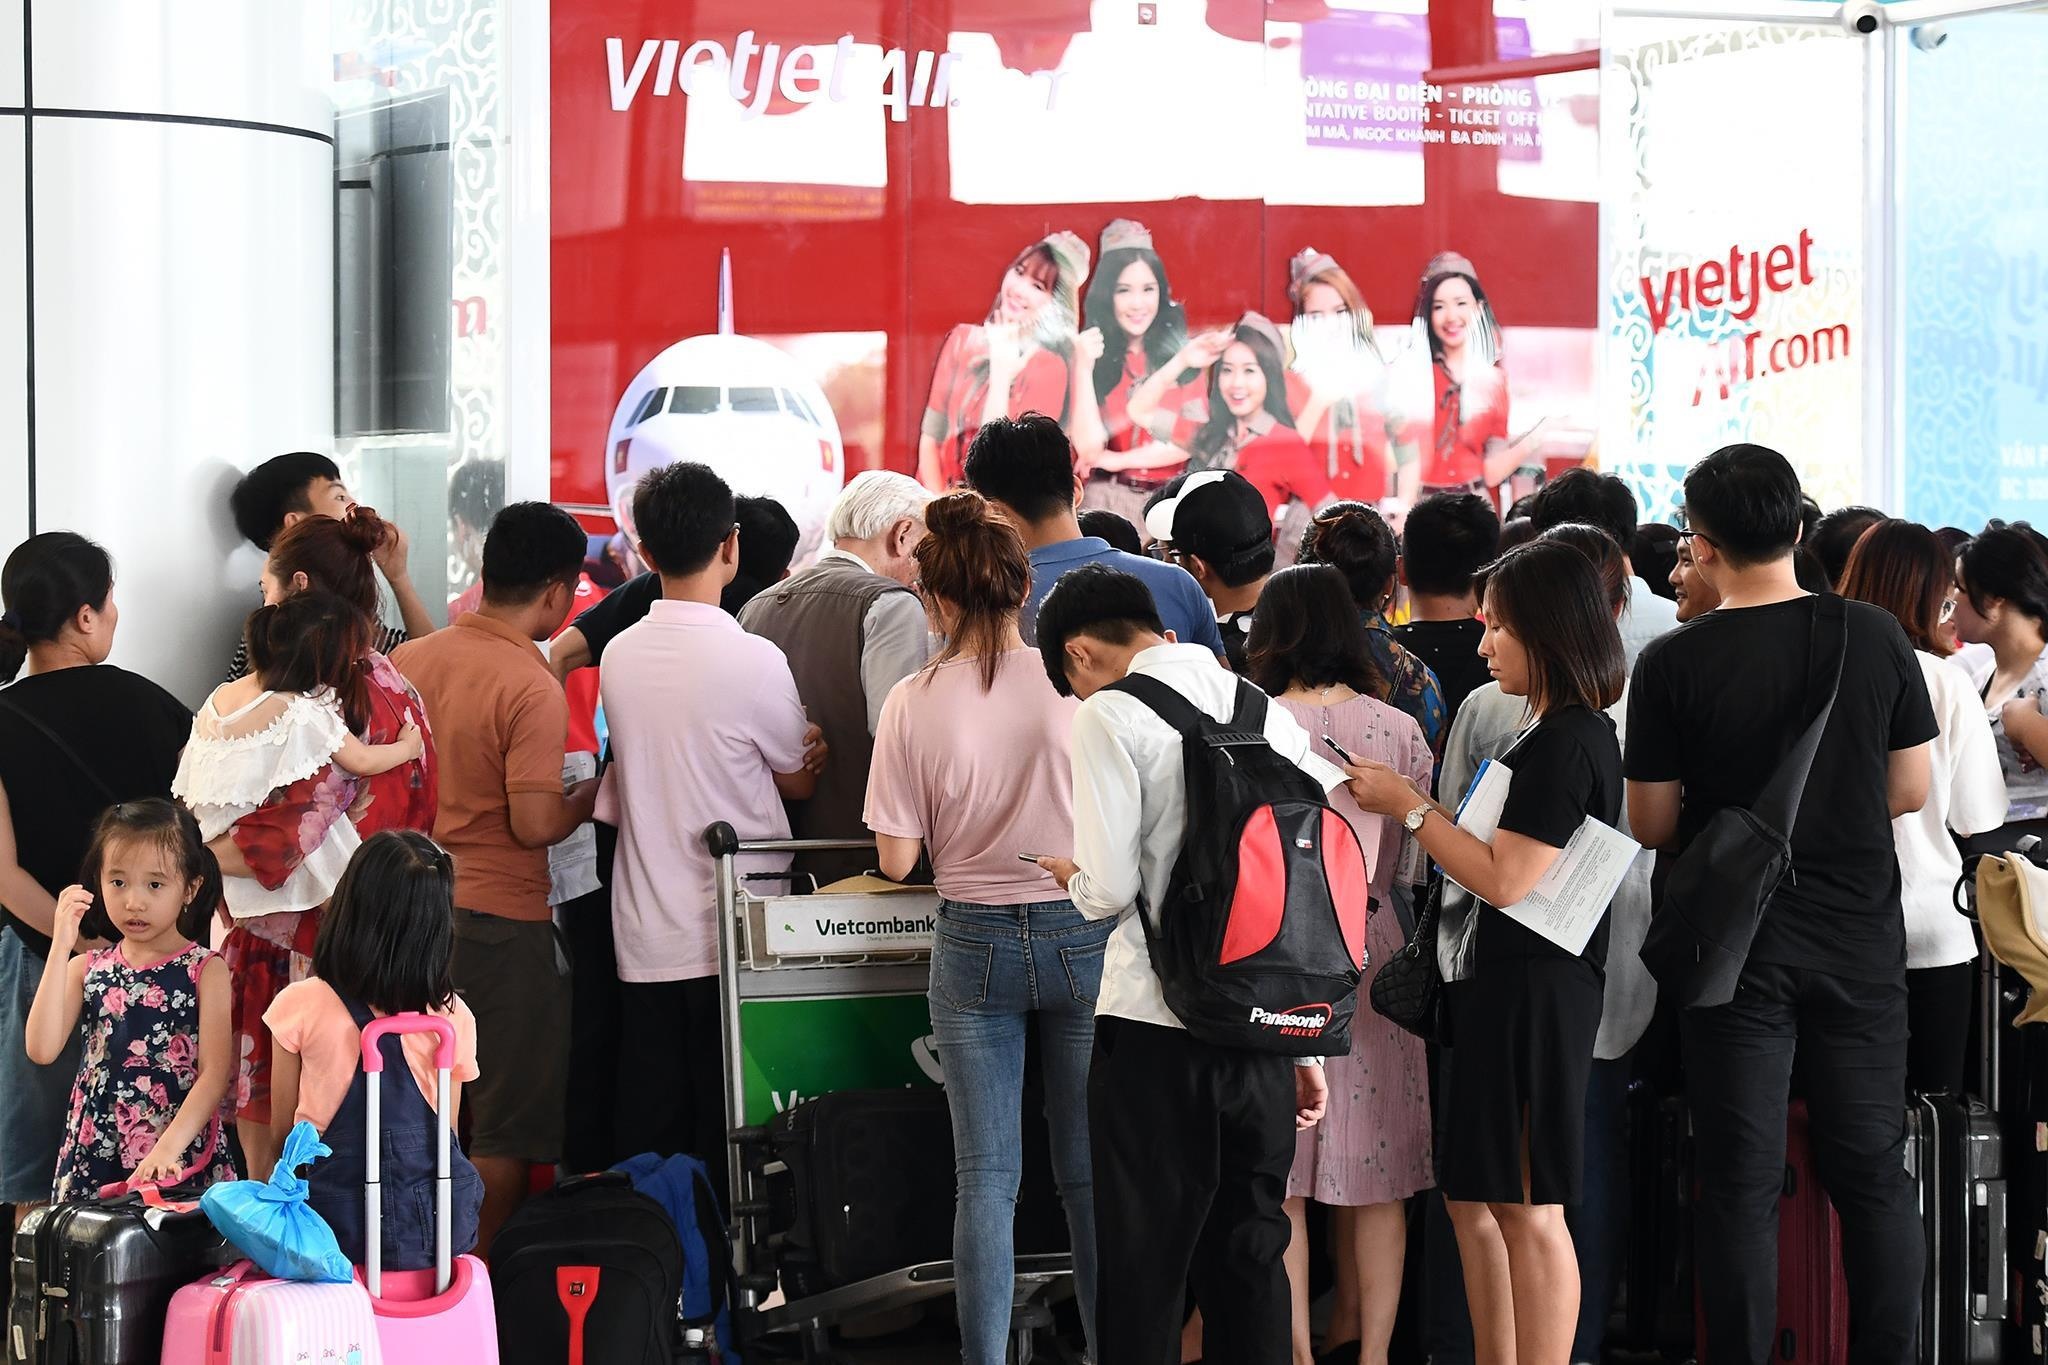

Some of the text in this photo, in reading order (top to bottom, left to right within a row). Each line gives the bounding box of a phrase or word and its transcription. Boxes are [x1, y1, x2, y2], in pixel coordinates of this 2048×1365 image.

[1396, 80, 1442, 106] DIỆN
[1462, 83, 1532, 107] PHÒNG
[1374, 105, 1430, 123] BOOTH
[1448, 107, 1501, 125] TICKET
[816, 915, 936, 936] Vietcombank
[1249, 1007, 1326, 1028] Panasonic
[1280, 1027, 1322, 1038] DIRECT
